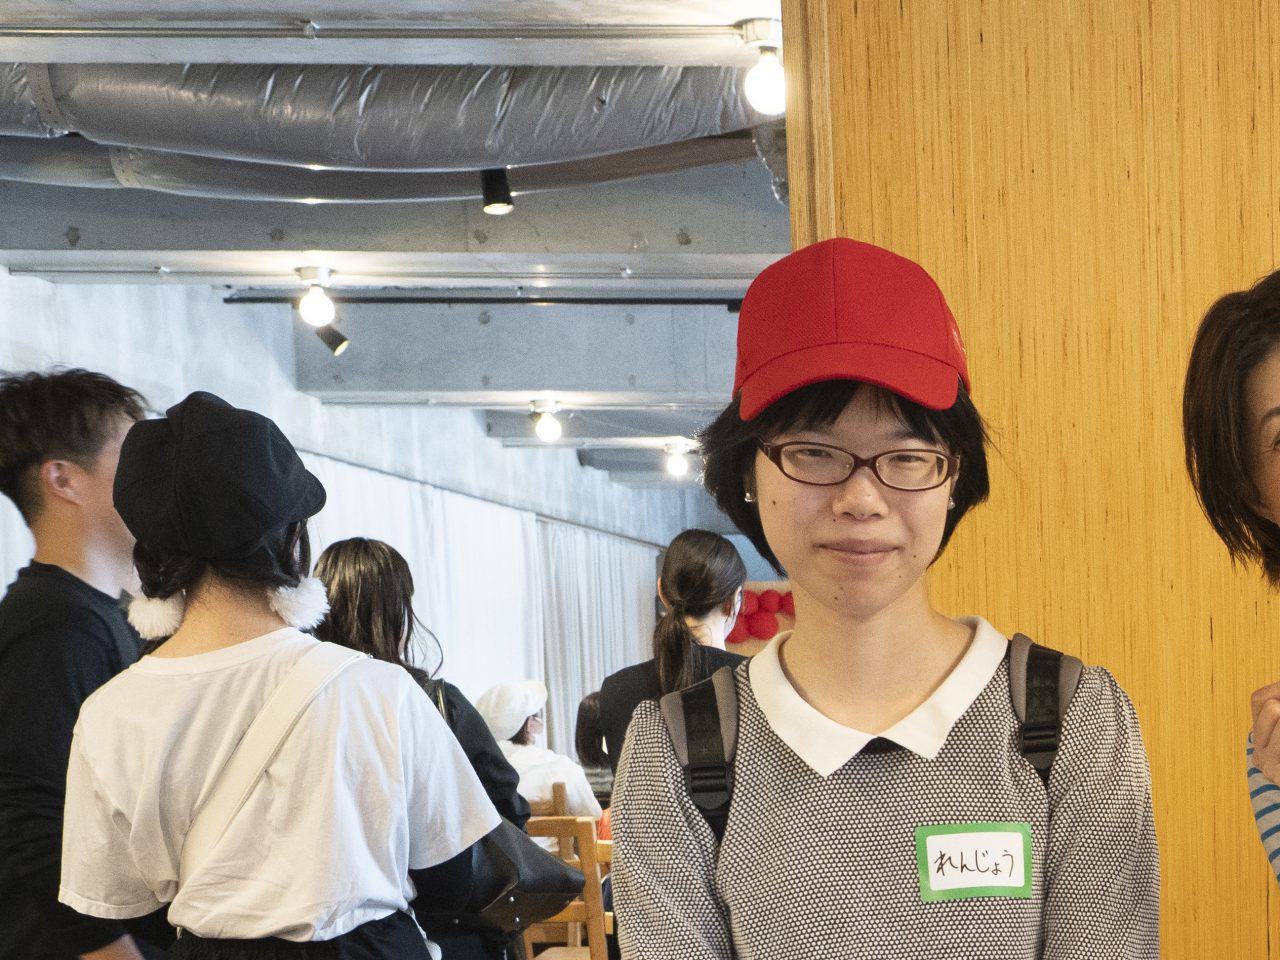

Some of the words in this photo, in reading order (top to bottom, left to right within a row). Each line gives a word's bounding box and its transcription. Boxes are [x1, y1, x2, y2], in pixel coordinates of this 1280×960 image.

[933, 849, 1015, 879] れんじょう
